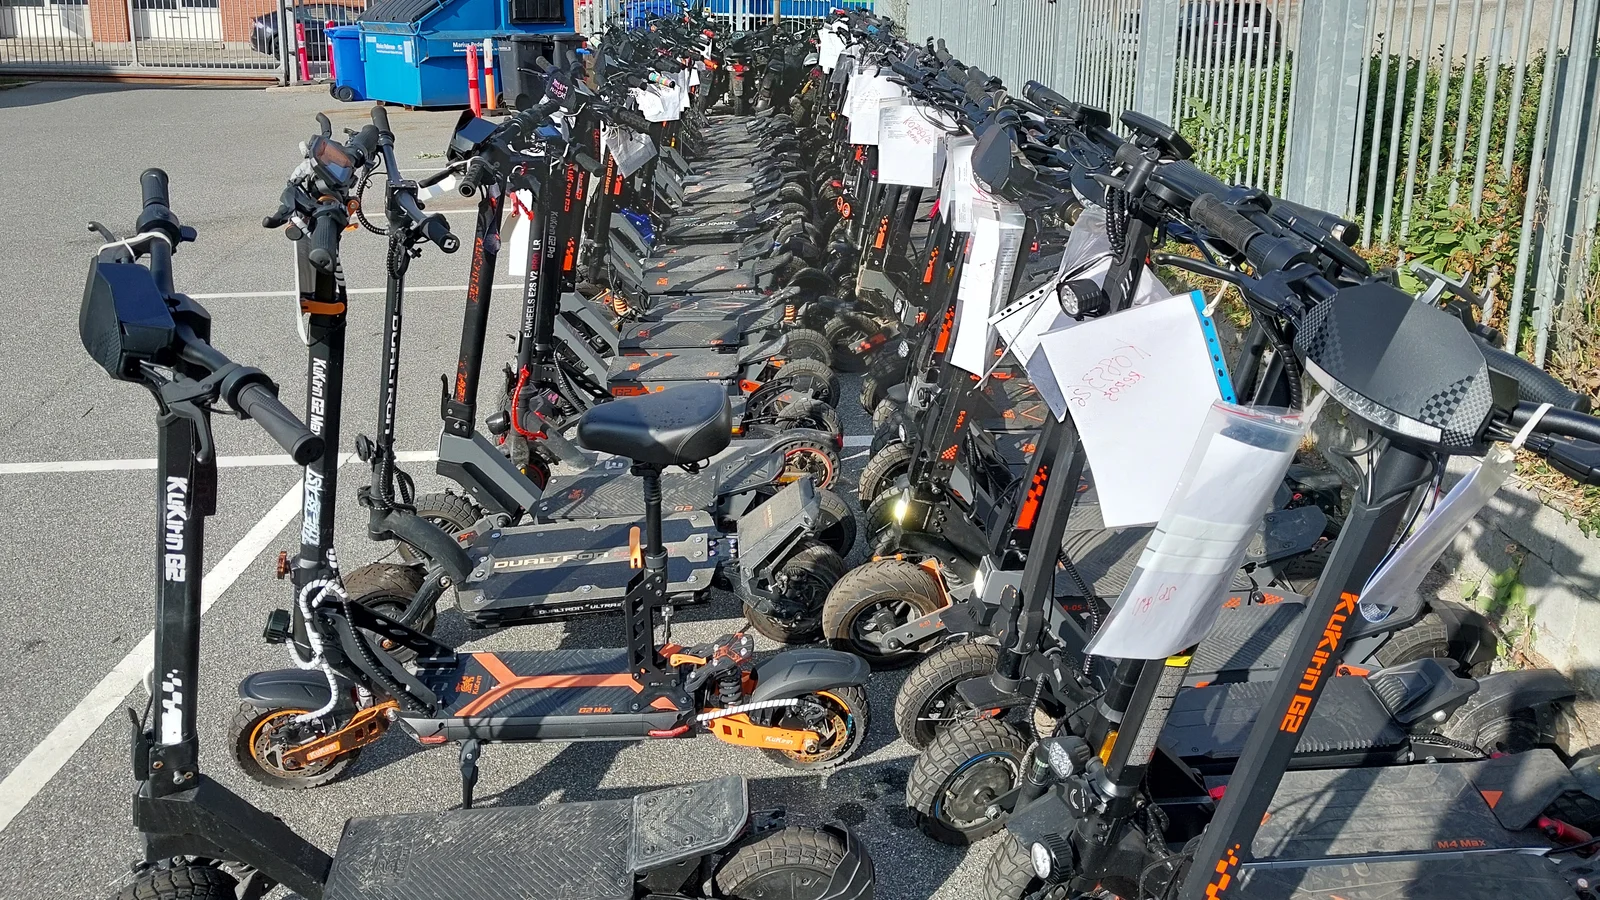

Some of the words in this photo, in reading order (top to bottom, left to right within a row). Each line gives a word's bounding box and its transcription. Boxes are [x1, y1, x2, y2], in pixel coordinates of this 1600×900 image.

[533, 239, 541, 251] LR
[531, 253, 540, 270] PRO
[530, 270, 538, 281] V2
[528, 282, 537, 297] E2S
[524, 297, 535, 338] E-WHEELS
[311, 357, 327, 397] KuKirin
[385, 315, 398, 435] DUALTRON
[615, 388, 632, 396] G2
[310, 396, 325, 416] G2
[166, 476, 188, 550] KuKirin
[165, 554, 186, 582] G2
[494, 551, 609, 569] DUALTRON
[538, 605, 584, 615] DUALTRON
[1298, 591, 1360, 691] KuKirin
[1279, 695, 1312, 733] G2
[1437, 840, 1459, 849] M4
[1460, 839, 1486, 848] Max
